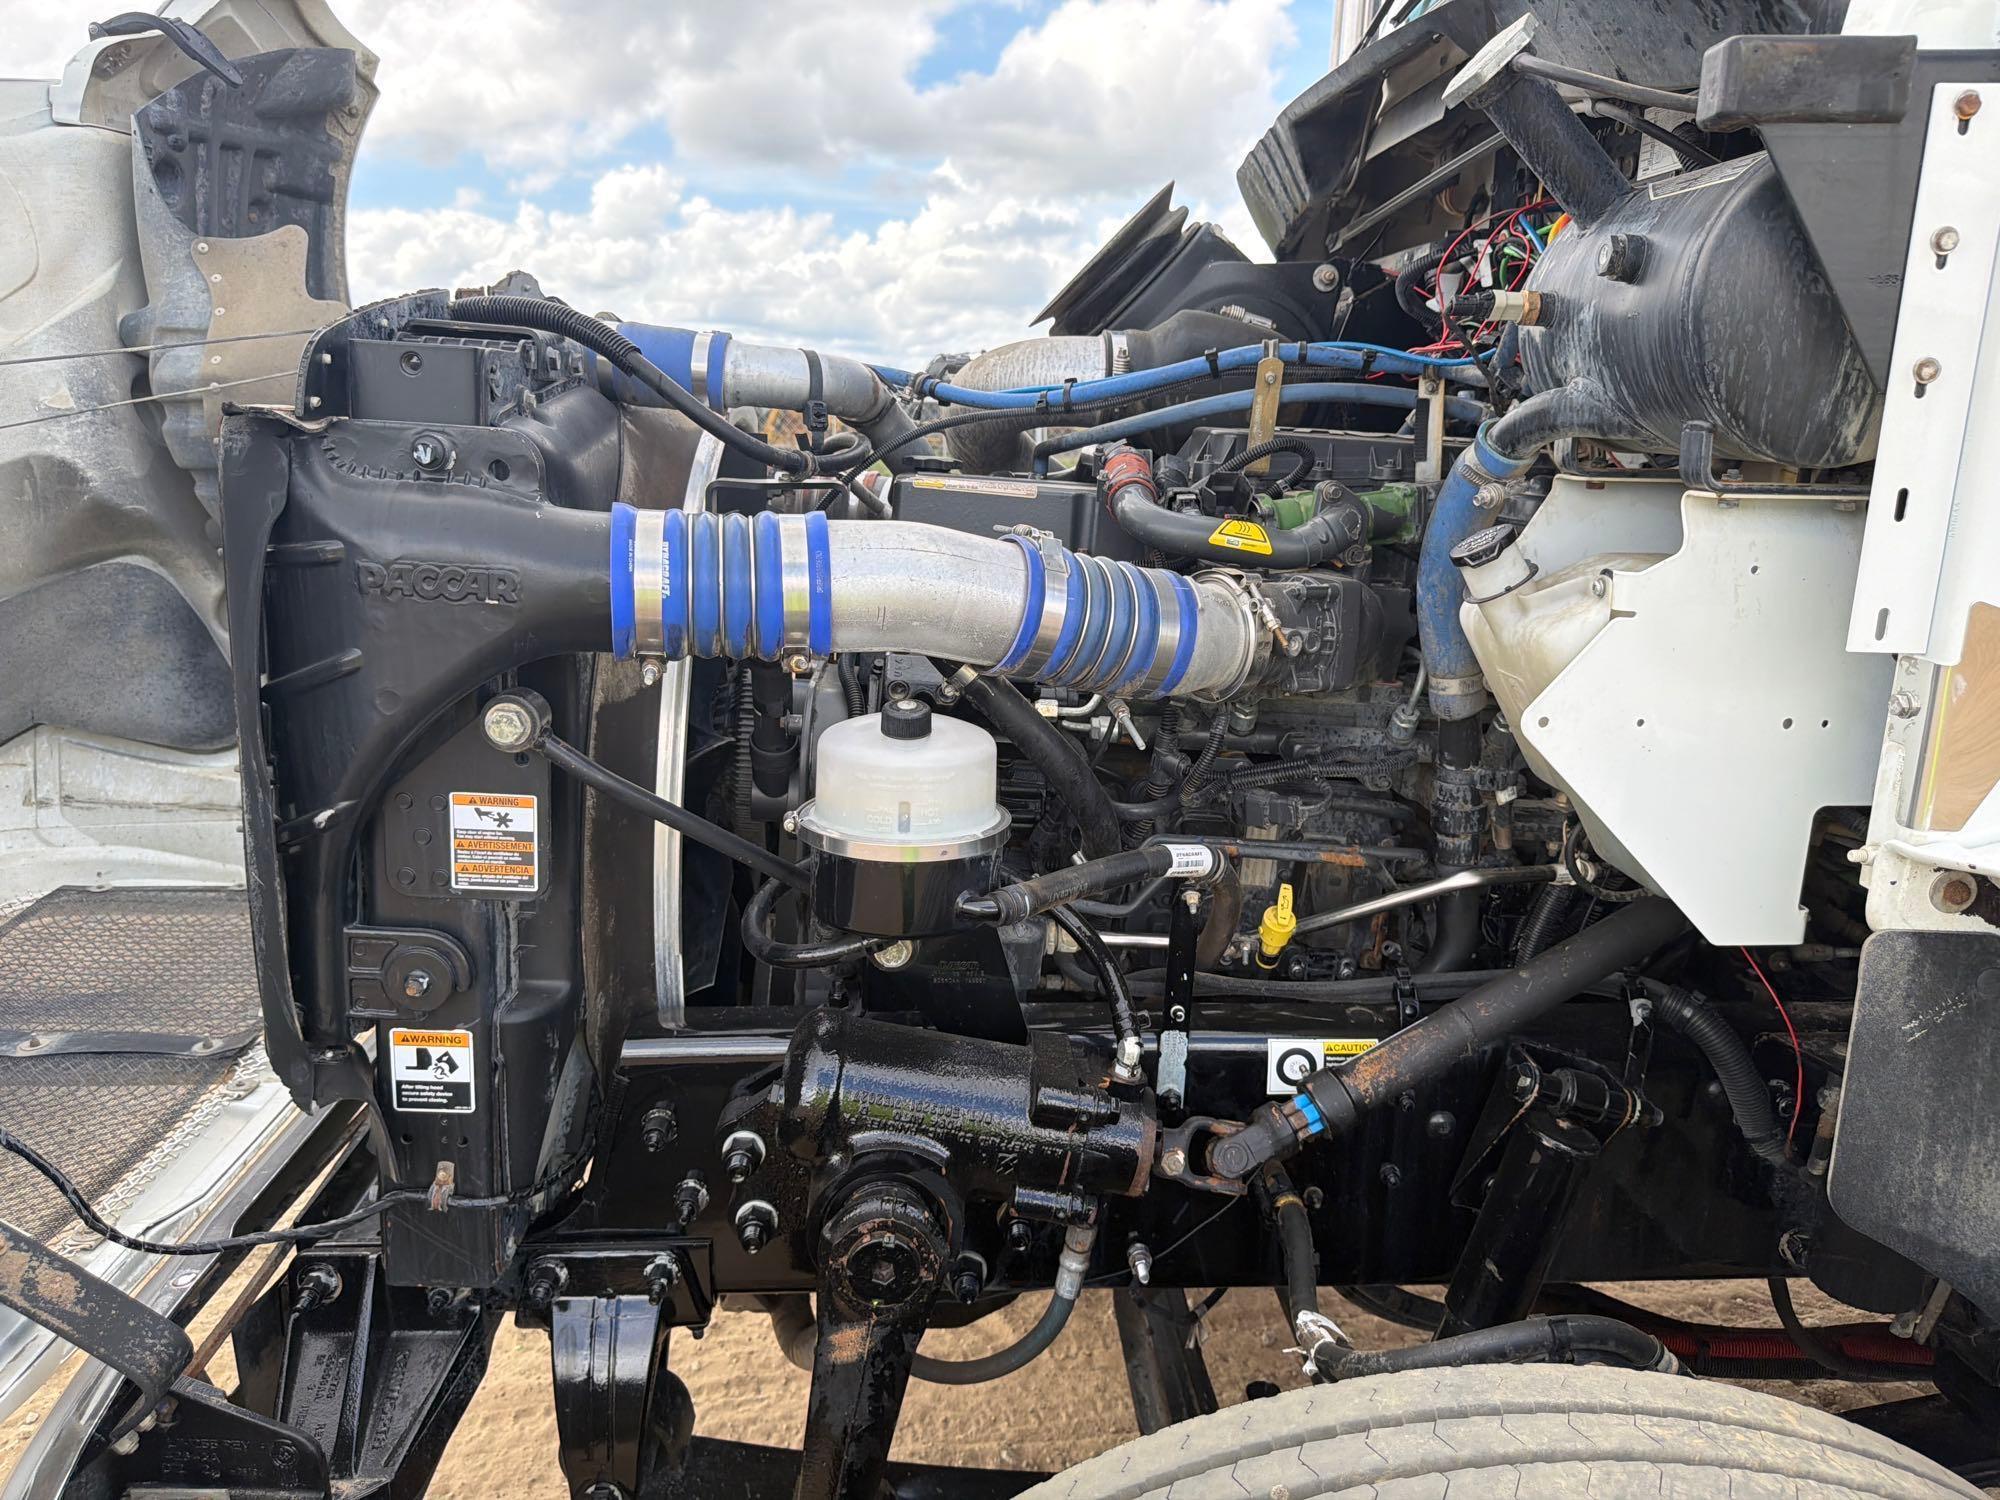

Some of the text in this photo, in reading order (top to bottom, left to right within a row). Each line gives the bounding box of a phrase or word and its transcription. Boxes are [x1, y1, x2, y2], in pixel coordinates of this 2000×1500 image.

[661, 541, 670, 596] DYNACRAFT
[356, 560, 519, 604] PACCAR
[479, 796, 519, 806] WARNING
[866, 815, 892, 825] COLD
[467, 841, 533, 851] AVERTISSEMENT
[472, 865, 529, 874] ADVERTENCIA
[410, 1034, 462, 1044] WARNING
